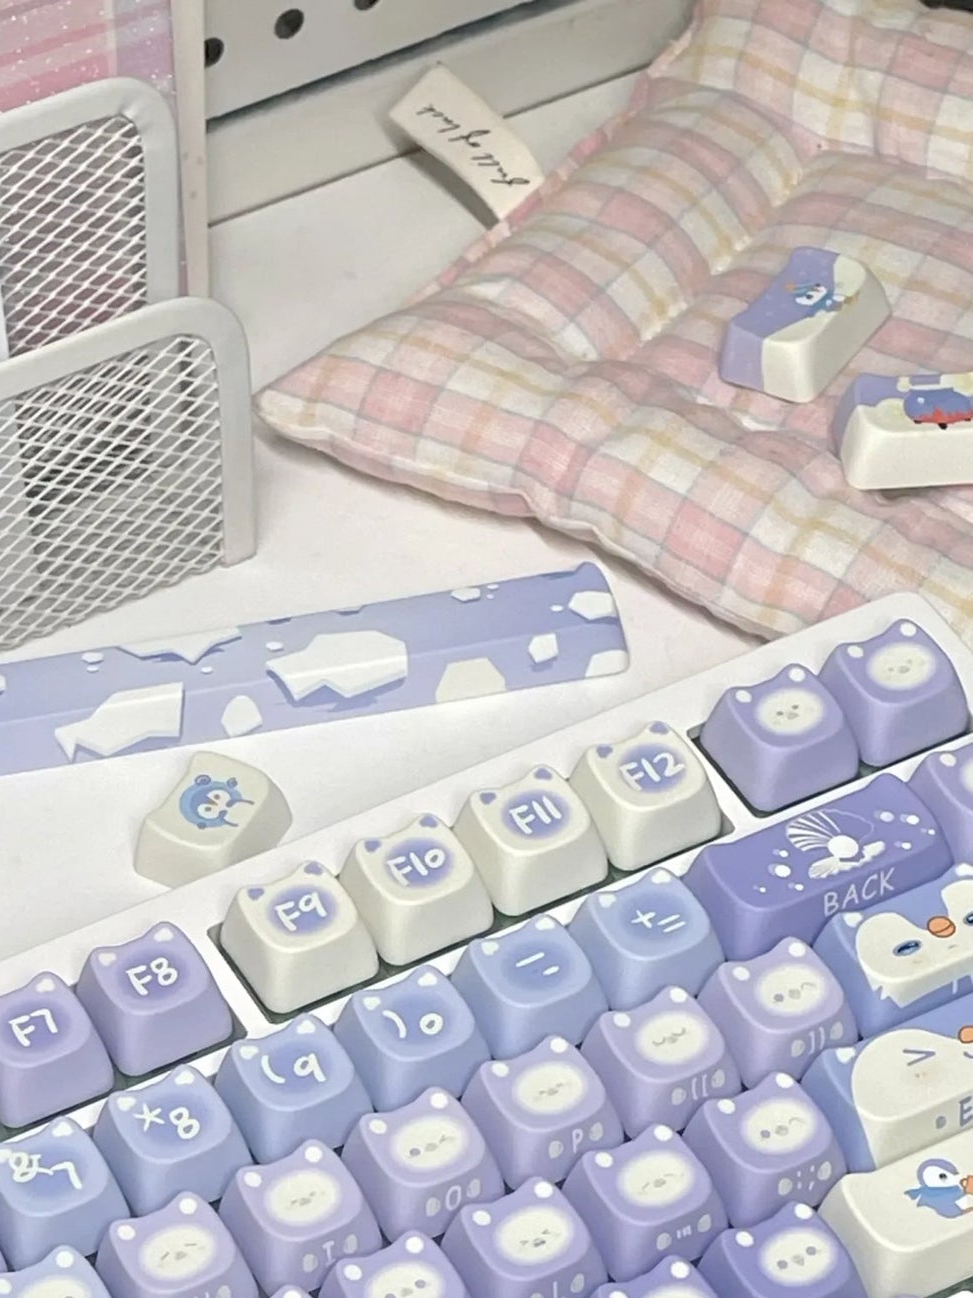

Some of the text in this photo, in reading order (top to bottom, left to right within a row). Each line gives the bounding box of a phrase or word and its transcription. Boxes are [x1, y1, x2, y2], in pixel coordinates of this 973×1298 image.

[448, 129, 491, 148] of
[471, 153, 530, 186] full
[619, 753, 685, 791] F12
[509, 796, 561, 834] F11
[387, 848, 445, 886] F10
[824, 867, 894, 917] BACK
[275, 892, 327, 932] F9
[126, 957, 177, 995] F8
[8, 1008, 58, 1046] F7
[572, 1128, 584, 1153] P
